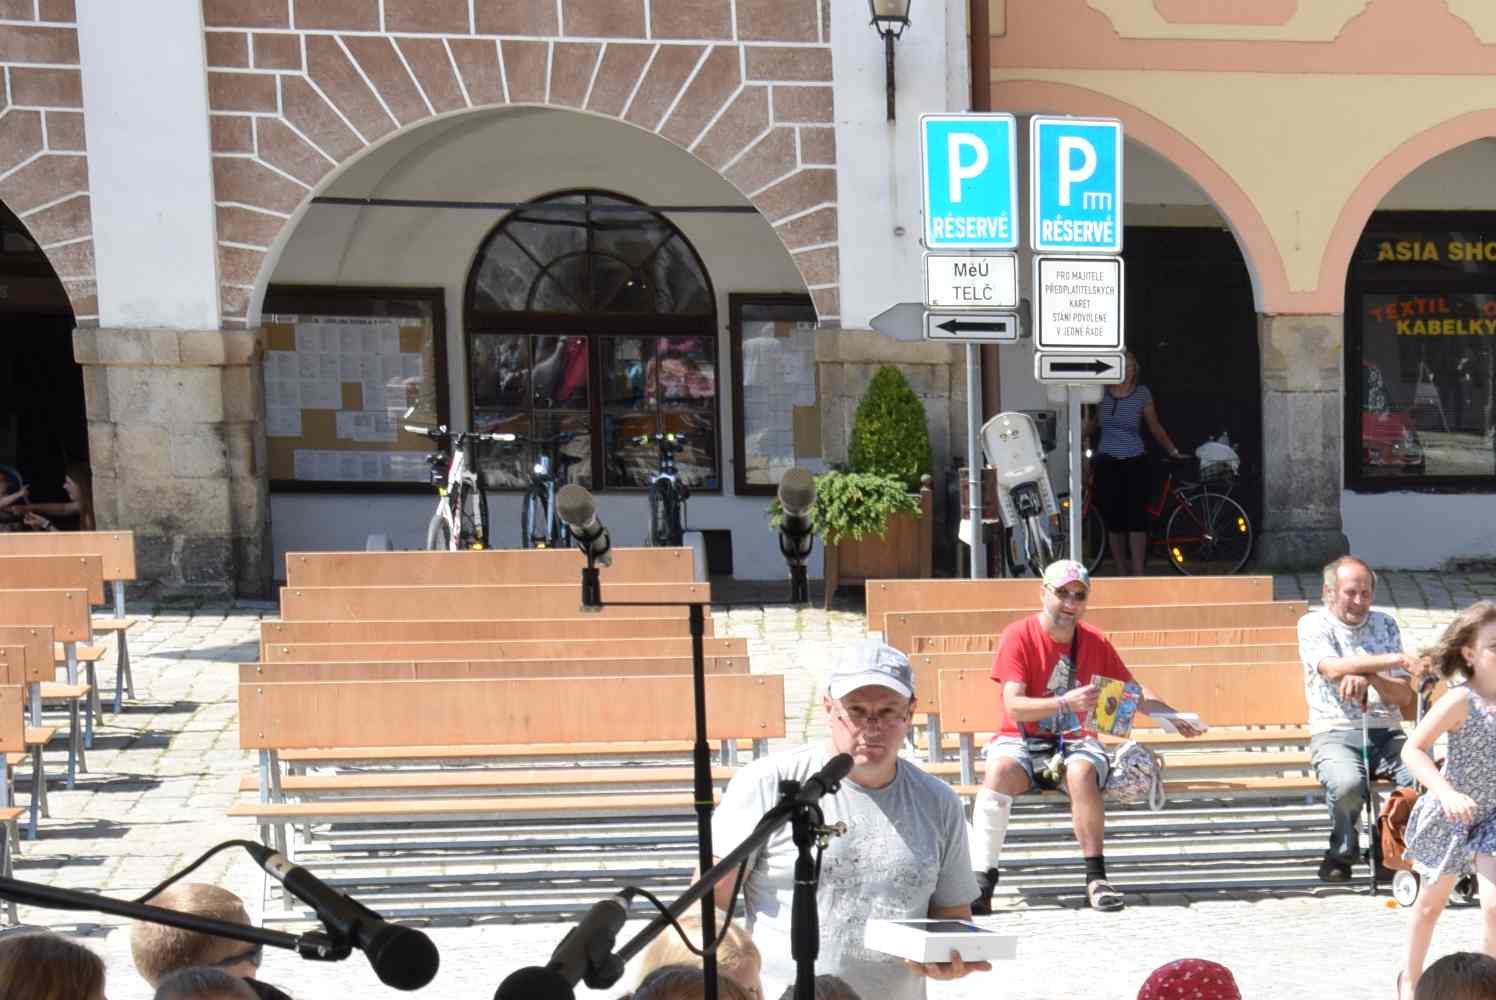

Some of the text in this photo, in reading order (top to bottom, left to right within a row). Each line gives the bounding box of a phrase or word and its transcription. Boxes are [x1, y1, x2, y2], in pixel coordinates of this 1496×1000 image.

[947, 132, 989, 204] P
[1059, 135, 1097, 206] P
[1377, 241, 1440, 262] ASIA
[952, 283, 993, 301] TELČ
